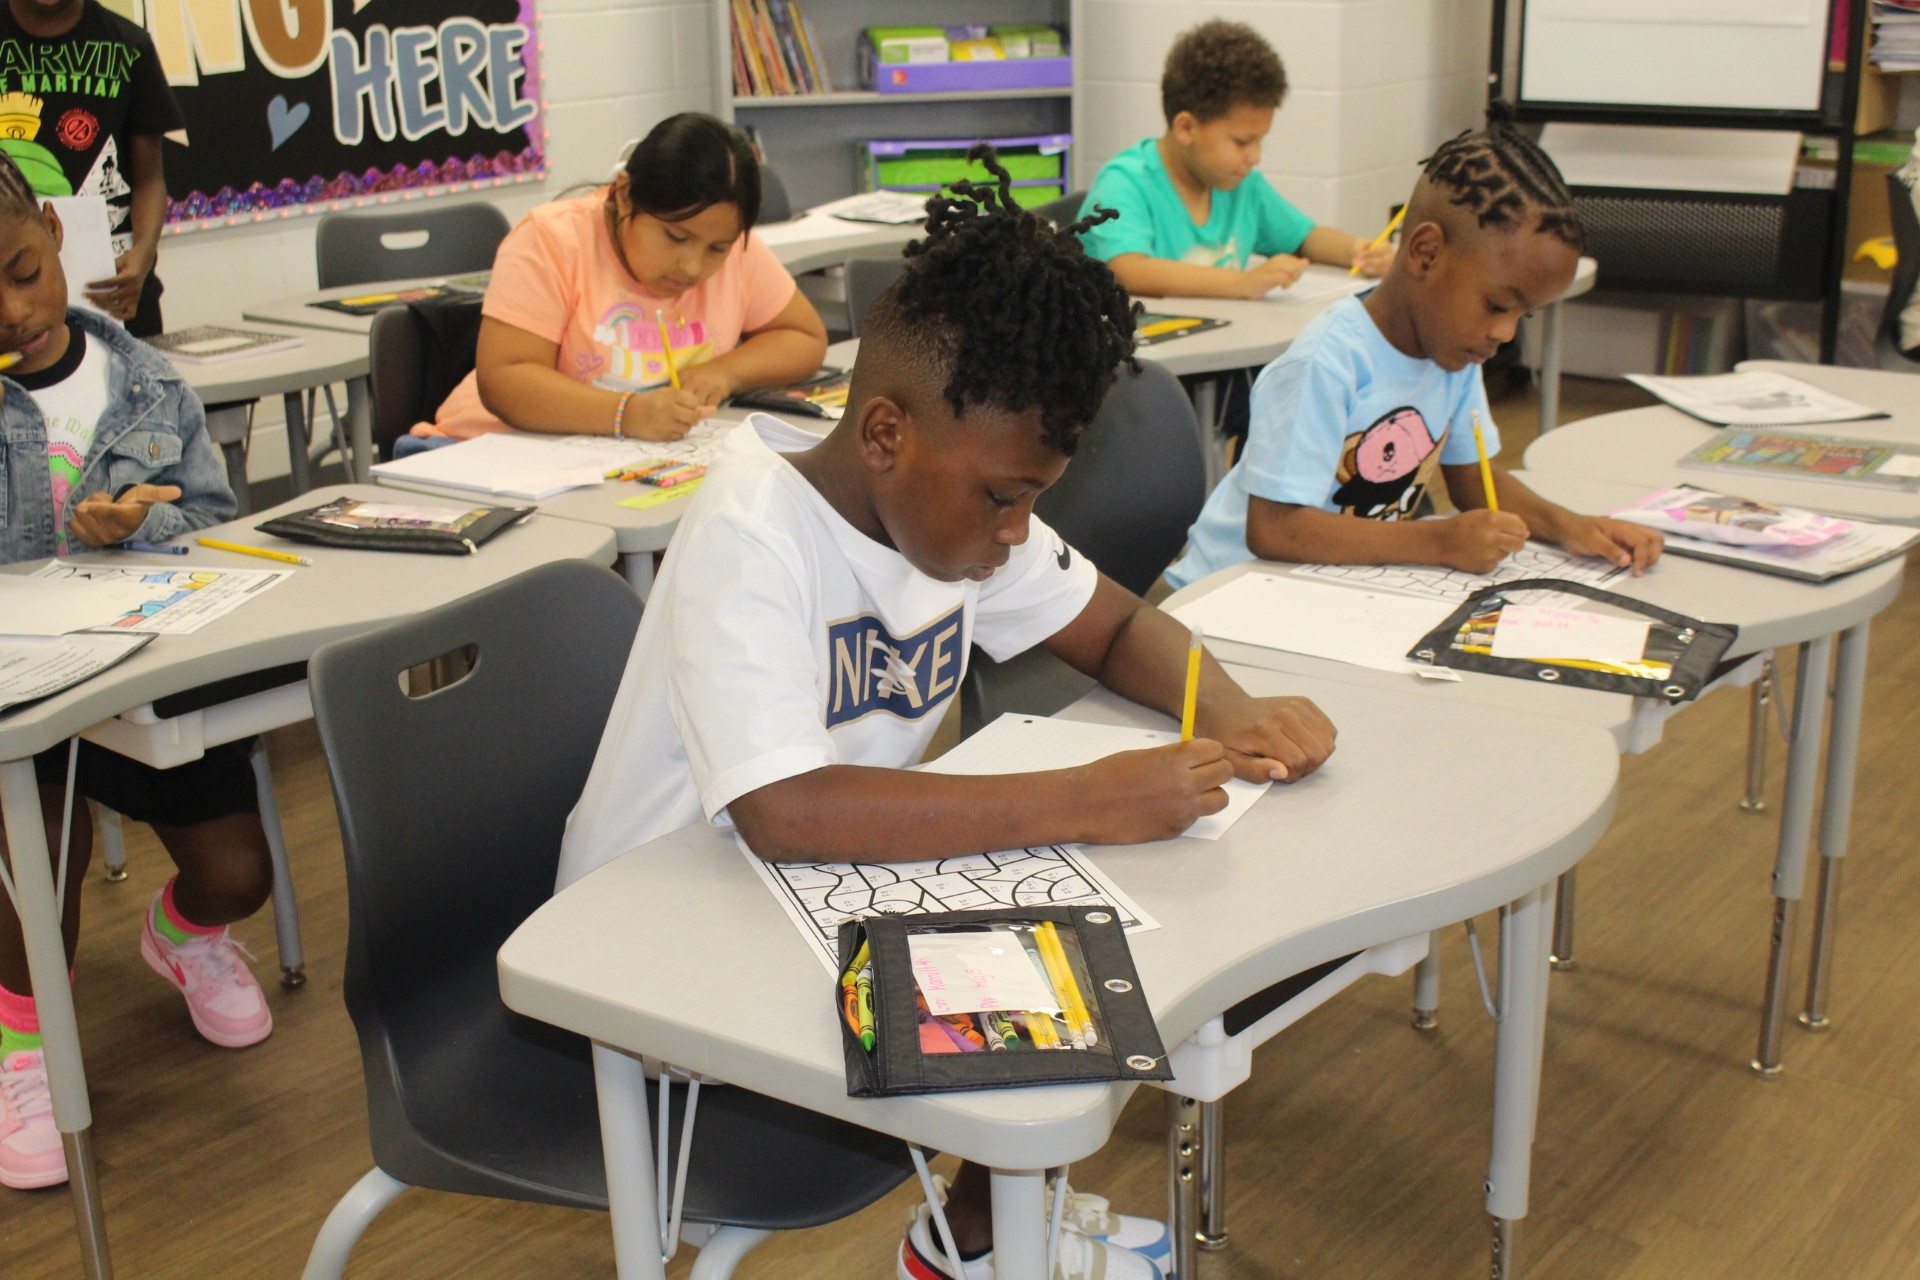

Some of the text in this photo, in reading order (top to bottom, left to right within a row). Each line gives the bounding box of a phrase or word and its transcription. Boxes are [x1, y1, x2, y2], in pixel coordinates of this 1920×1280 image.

[0, 39, 141, 82] ARVIN
[21, 73, 121, 98] MARTIAN
[329, 16, 538, 146] HERE
[832, 621, 959, 714] NIKE
